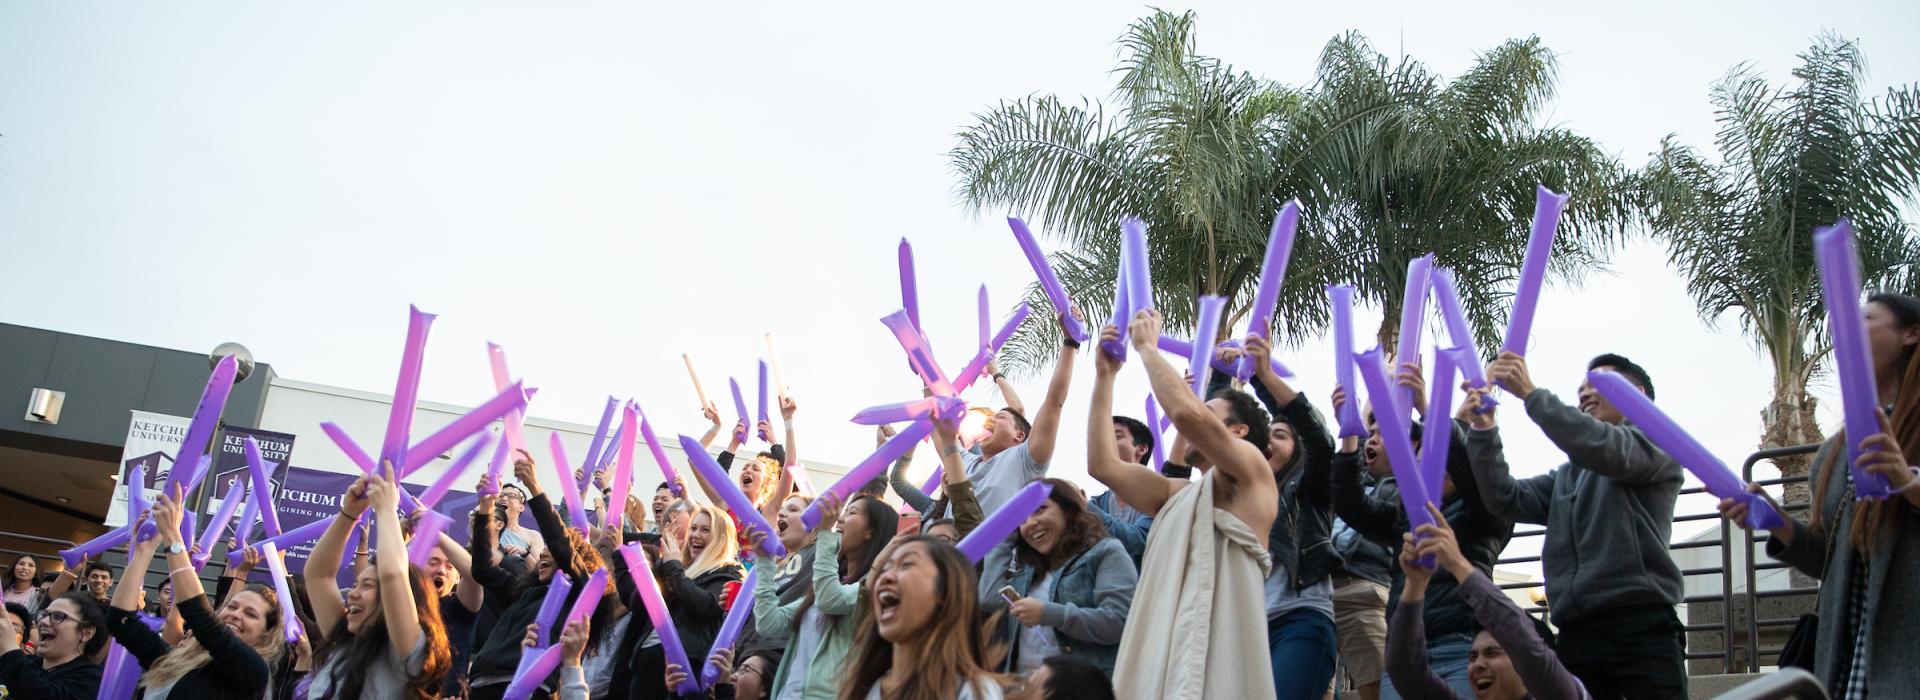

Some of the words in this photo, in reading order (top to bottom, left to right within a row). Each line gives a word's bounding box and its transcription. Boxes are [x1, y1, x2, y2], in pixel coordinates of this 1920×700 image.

[131, 430, 184, 444] UNIVERSI
[224, 435, 290, 453] KEHUM
[281, 489, 336, 506] TCHUM
[280, 507, 312, 516] GINING
